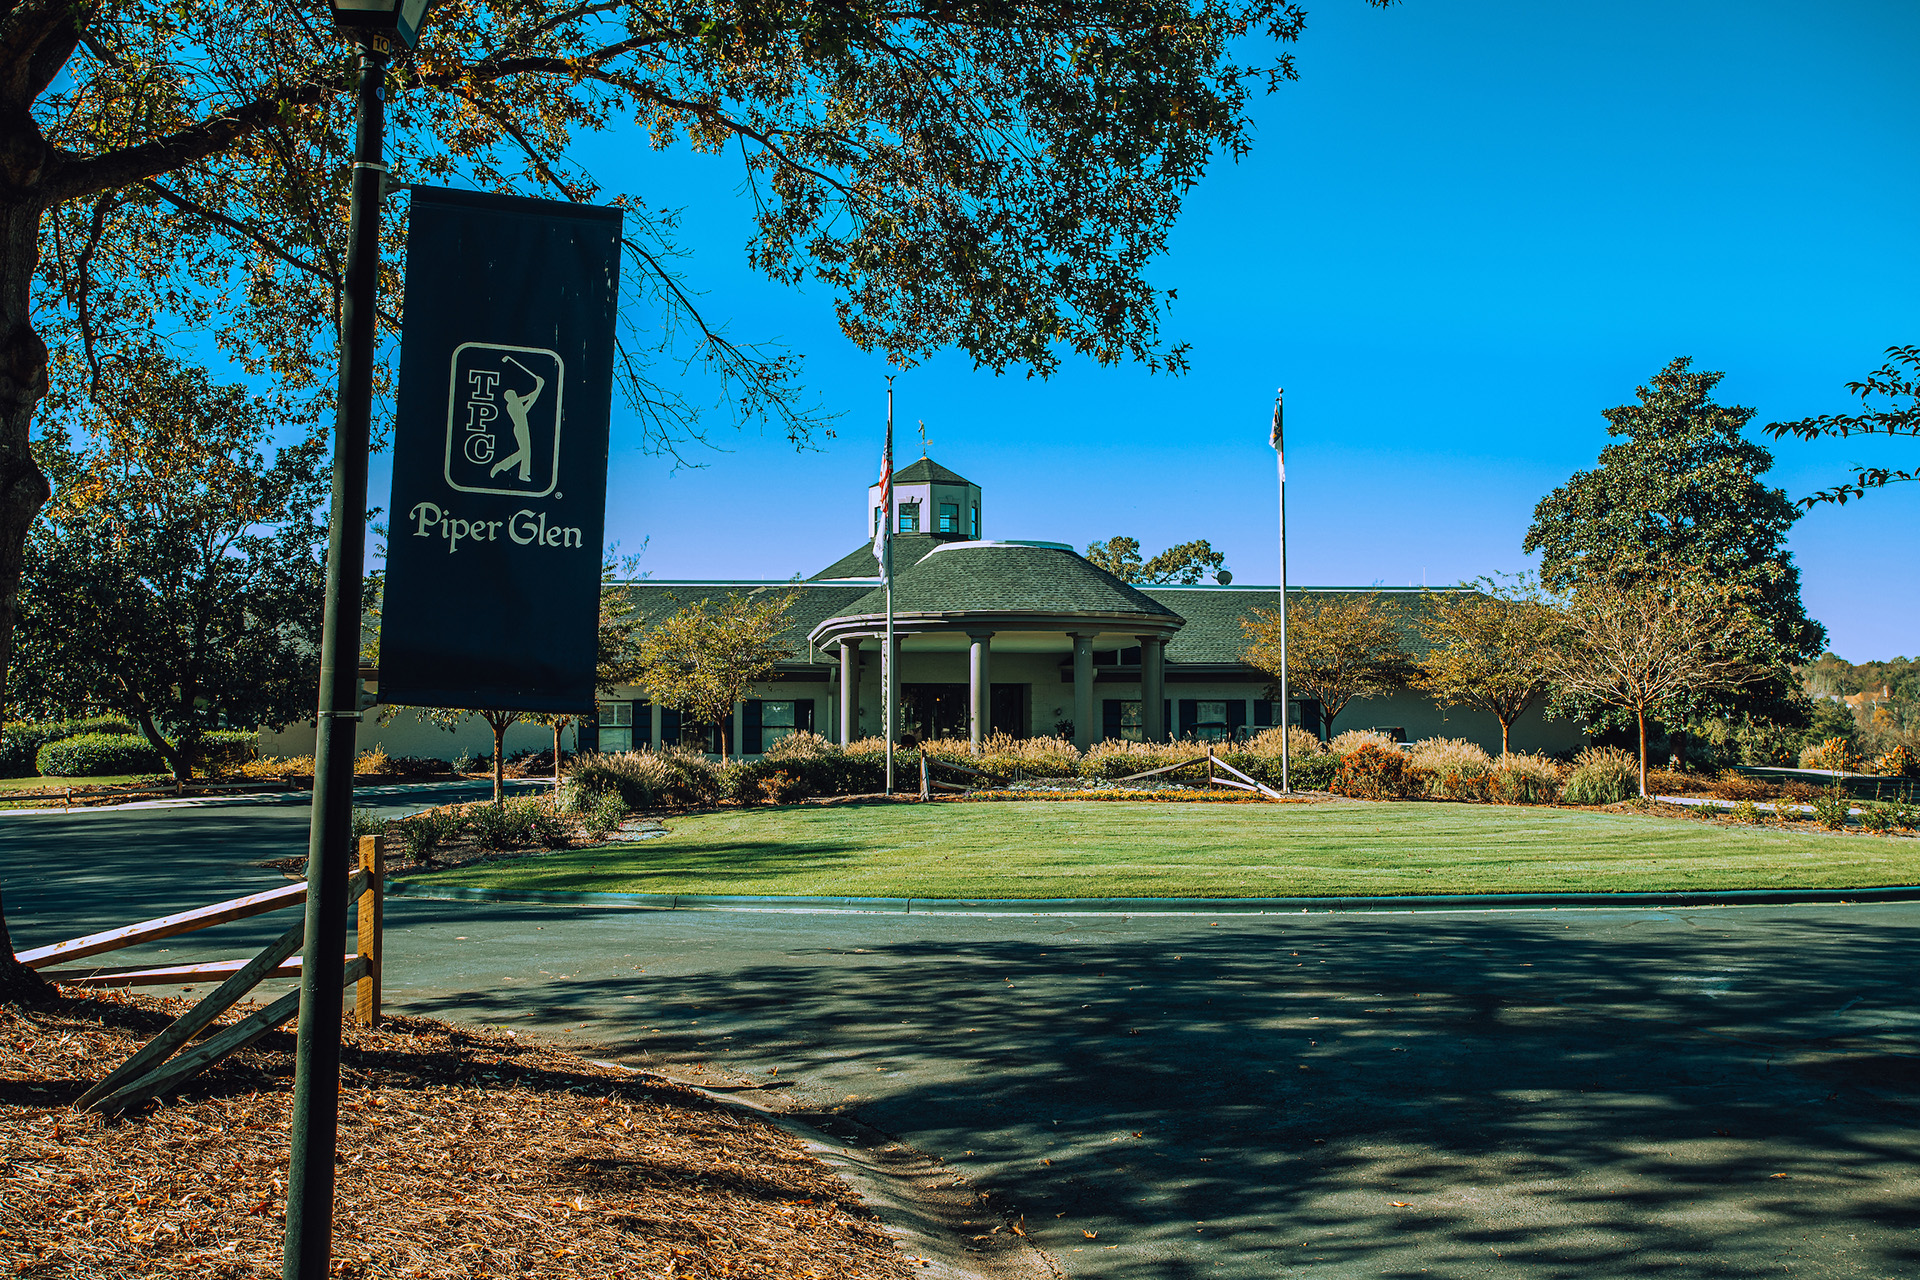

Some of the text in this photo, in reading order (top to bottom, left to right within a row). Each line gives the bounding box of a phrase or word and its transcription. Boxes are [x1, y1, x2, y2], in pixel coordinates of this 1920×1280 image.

[375, 37, 389, 52] 10
[464, 369, 500, 464] TPC
[409, 502, 583, 554] Piper Glen
